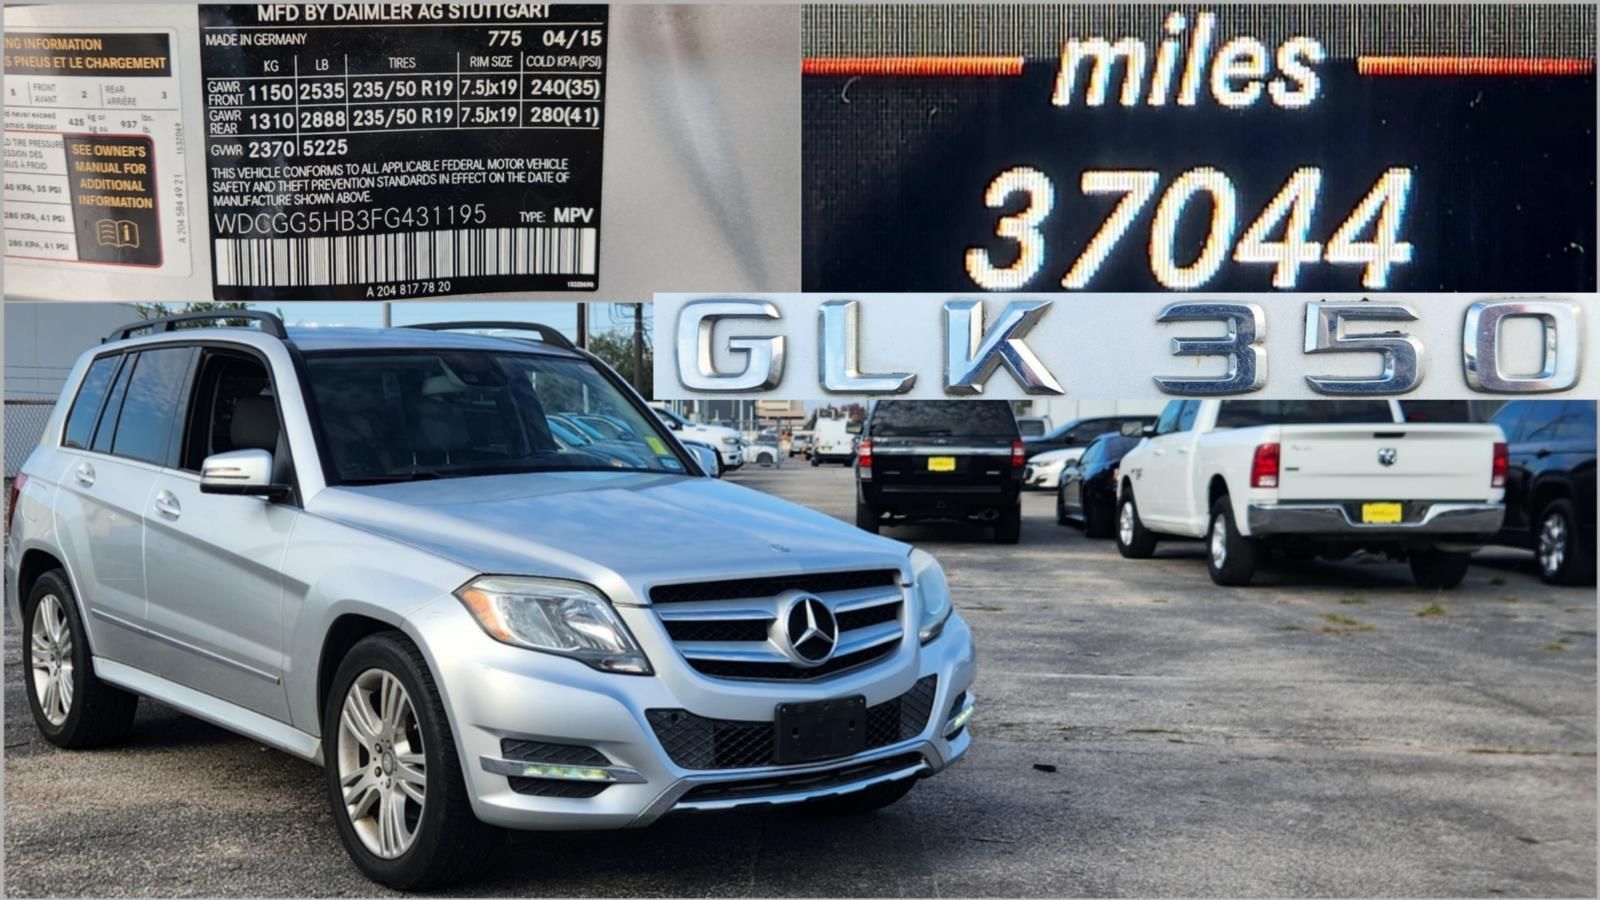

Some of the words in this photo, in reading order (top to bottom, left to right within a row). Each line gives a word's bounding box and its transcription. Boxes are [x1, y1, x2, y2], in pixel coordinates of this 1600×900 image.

[258, 4, 299, 22] MFD
[304, 4, 328, 20] BY
[334, 4, 413, 20] DAIMLER
[418, 4, 443, 19] AG
[449, 4, 550, 18] STUTTGART
[25, 38, 102, 50] INFORMATION
[206, 34, 238, 46] MADE
[240, 34, 251, 46] IN
[254, 34, 307, 46] GERMANY
[488, 30, 522, 46] 775
[542, 30, 602, 49] 04/15
[15, 56, 50, 68] PNEUS
[54, 56, 65, 68] ET
[70, 57, 82, 68] LE
[86, 57, 166, 69] CHARGEMENT
[264, 60, 279, 72] KG
[316, 59, 329, 70] LB
[388, 56, 416, 69] TIRES
[470, 56, 489, 68] RIM
[492, 56, 512, 68] SIZE
[526, 56, 556, 68] COLD
[1051, 11, 1327, 110] miles
[33, 84, 56, 92] FRONT
[208, 82, 240, 93] GAWR
[249, 84, 294, 101] 1150
[300, 82, 344, 100] 2535
[352, 80, 416, 100] 235/50
[421, 80, 453, 96] R19
[461, 80, 518, 96] 7.5Jx19
[531, 79, 600, 100] 240(35)
[208, 94, 244, 106] FRONT
[68, 118, 84, 127] 425
[120, 120, 138, 128] 937
[209, 110, 242, 122] GAWR
[250, 112, 294, 130] 1310
[300, 110, 346, 128] 2888
[353, 108, 417, 128] 235/50
[422, 107, 453, 124] R19
[461, 106, 518, 124] 7.5Jx19
[530, 106, 600, 127] 280(41)
[210, 122, 238, 134] REAR
[12, 138, 26, 147] TIRE
[29, 140, 64, 148] PRESSURE
[211, 144, 244, 156] GVWR
[248, 141, 294, 158] 2370
[303, 139, 348, 156] 5225
[72, 144, 92, 156] SEE
[95, 145, 146, 158] OWNER'S
[26, 161, 47, 170] FROID
[75, 162, 121, 174] MANUAL
[124, 164, 146, 174] FOR
[212, 168, 235, 179] THIS
[238, 166, 281, 178] VEHICLE
[282, 164, 344, 178] CONFORMS
[346, 164, 359, 175] TO
[362, 163, 379, 175] ALL
[382, 160, 440, 173] APPLICABLE
[442, 159, 485, 171] FEDERAL
[487, 158, 524, 170] MOTOR
[526, 158, 568, 170] VEHICLE
[80, 178, 146, 191] ADDITIONAL
[174, 174, 182, 185] 21
[212, 181, 250, 193] SAFETY
[252, 180, 276, 192] AND
[278, 179, 310, 192] THEFT
[312, 177, 374, 190] PREVENTION
[376, 174, 437, 188] STANDARDS
[439, 173, 450, 184] IN
[452, 172, 487, 184] EFFECT
[488, 172, 504, 184] ON
[506, 172, 526, 183] THE
[528, 172, 554, 183] DATE
[556, 172, 570, 183] OF
[16, 184, 35, 194] KPA,
[174, 188, 184, 198] 49
[78, 196, 152, 208] INFORMATION
[213, 194, 292, 207] MANUFACTURE
[294, 192, 334, 205] SHOWN
[336, 191, 373, 204] ABOVE.
[176, 201, 185, 217] 584
[519, 211, 546, 223] TYPE:
[554, 207, 594, 223] MPV
[20, 212, 39, 222] KPA,
[214, 203, 487, 234] WDCGG5HB3FG431195
[176, 220, 186, 235] 204
[965, 165, 1416, 291] 37044
[24, 240, 43, 251] KPA,
[366, 287, 374, 297] A
[377, 285, 396, 296] 204
[400, 283, 418, 295] 817
[422, 282, 434, 293] 78
[438, 281, 450, 292] 20
[674, 300, 1066, 395] GLK
[1153, 300, 1584, 394] 350
